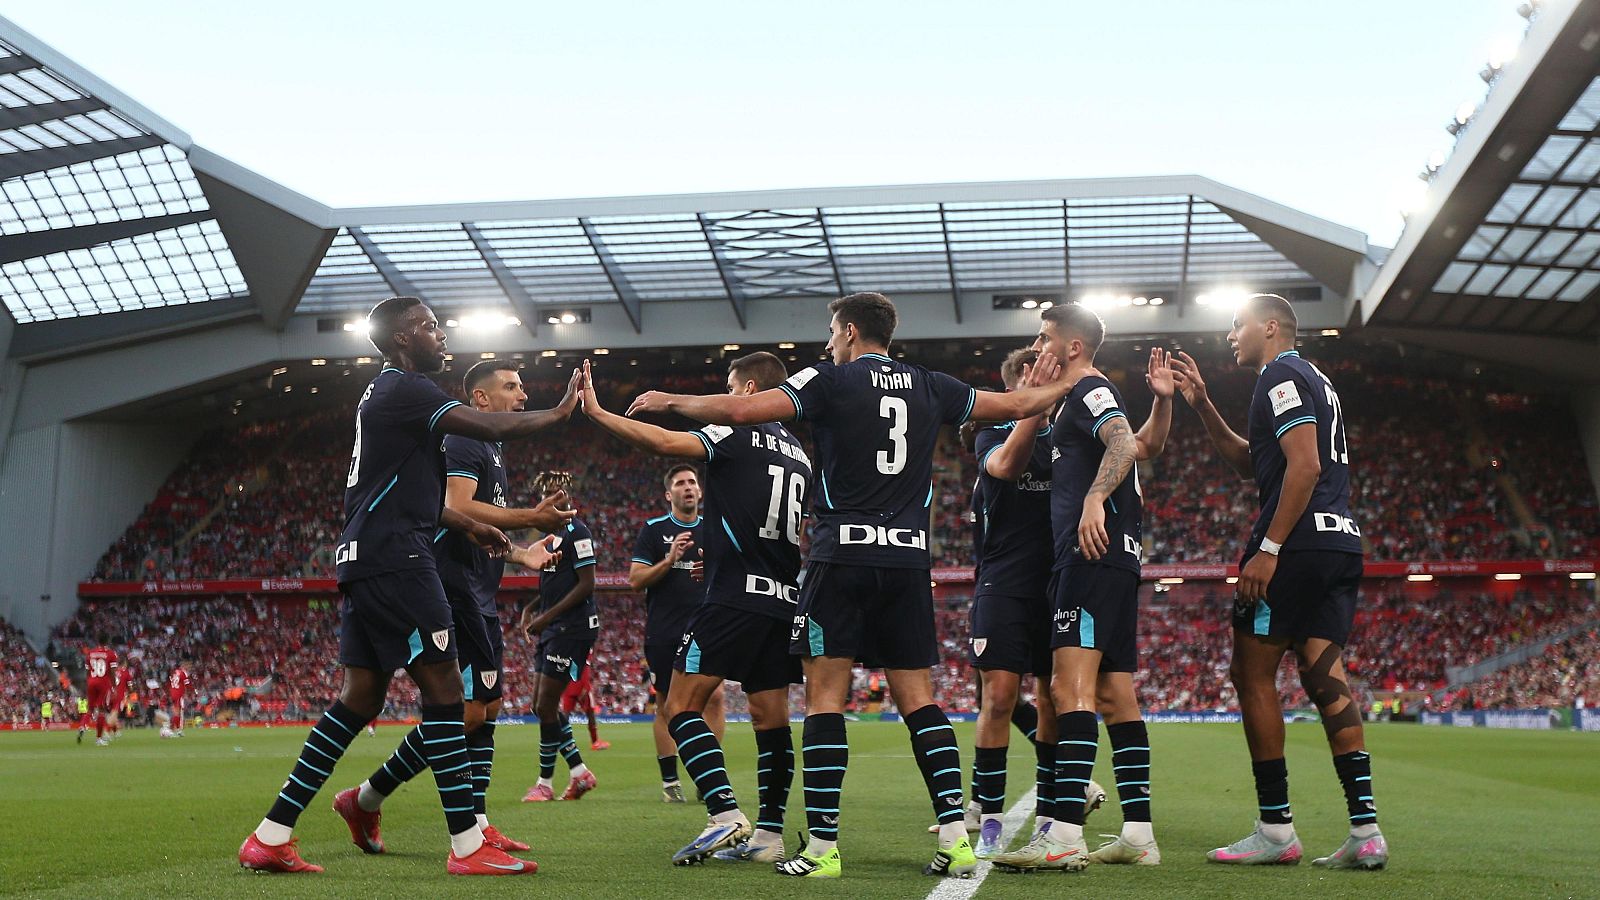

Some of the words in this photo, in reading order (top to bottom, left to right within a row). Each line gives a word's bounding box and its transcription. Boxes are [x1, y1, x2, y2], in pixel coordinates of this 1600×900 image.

[751, 431, 764, 448] R.
[765, 434, 778, 452] DE
[877, 396, 908, 475] 3
[759, 464, 806, 546] 16
[839, 524, 927, 551] DIGI
[1314, 512, 1361, 537] DIG
[334, 540, 358, 566] GI
[745, 573, 800, 605] DIG
[1053, 608, 1077, 622] eling
